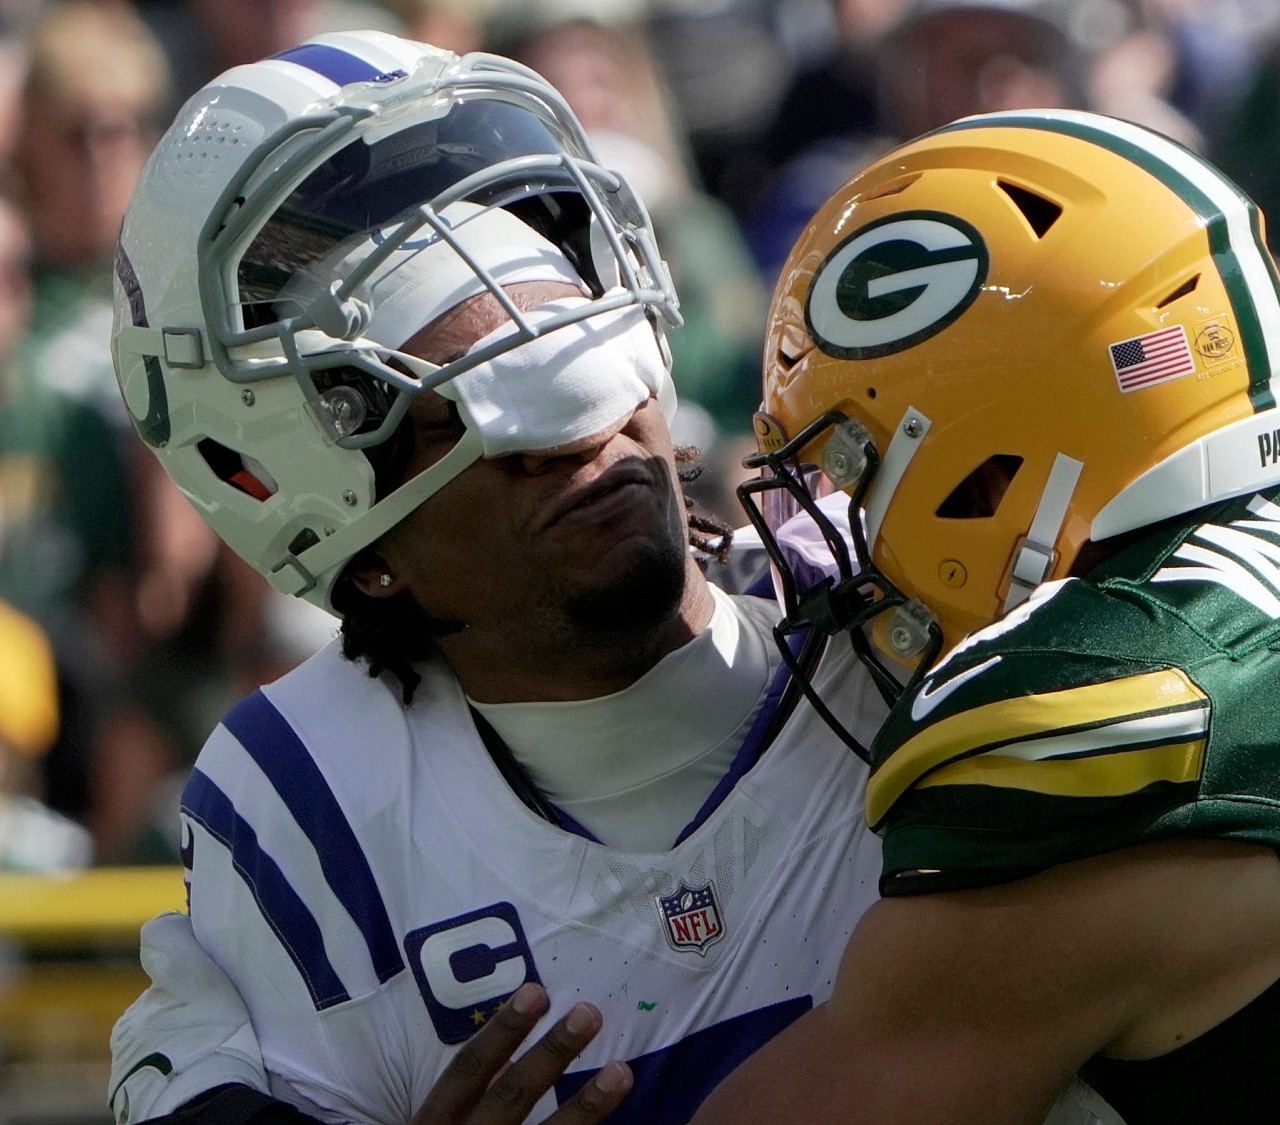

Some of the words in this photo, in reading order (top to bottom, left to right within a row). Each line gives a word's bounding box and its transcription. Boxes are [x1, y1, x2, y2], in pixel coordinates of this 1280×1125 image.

[808, 219, 980, 350] G
[419, 916, 527, 1010] C
[671, 909, 717, 942] NFL
